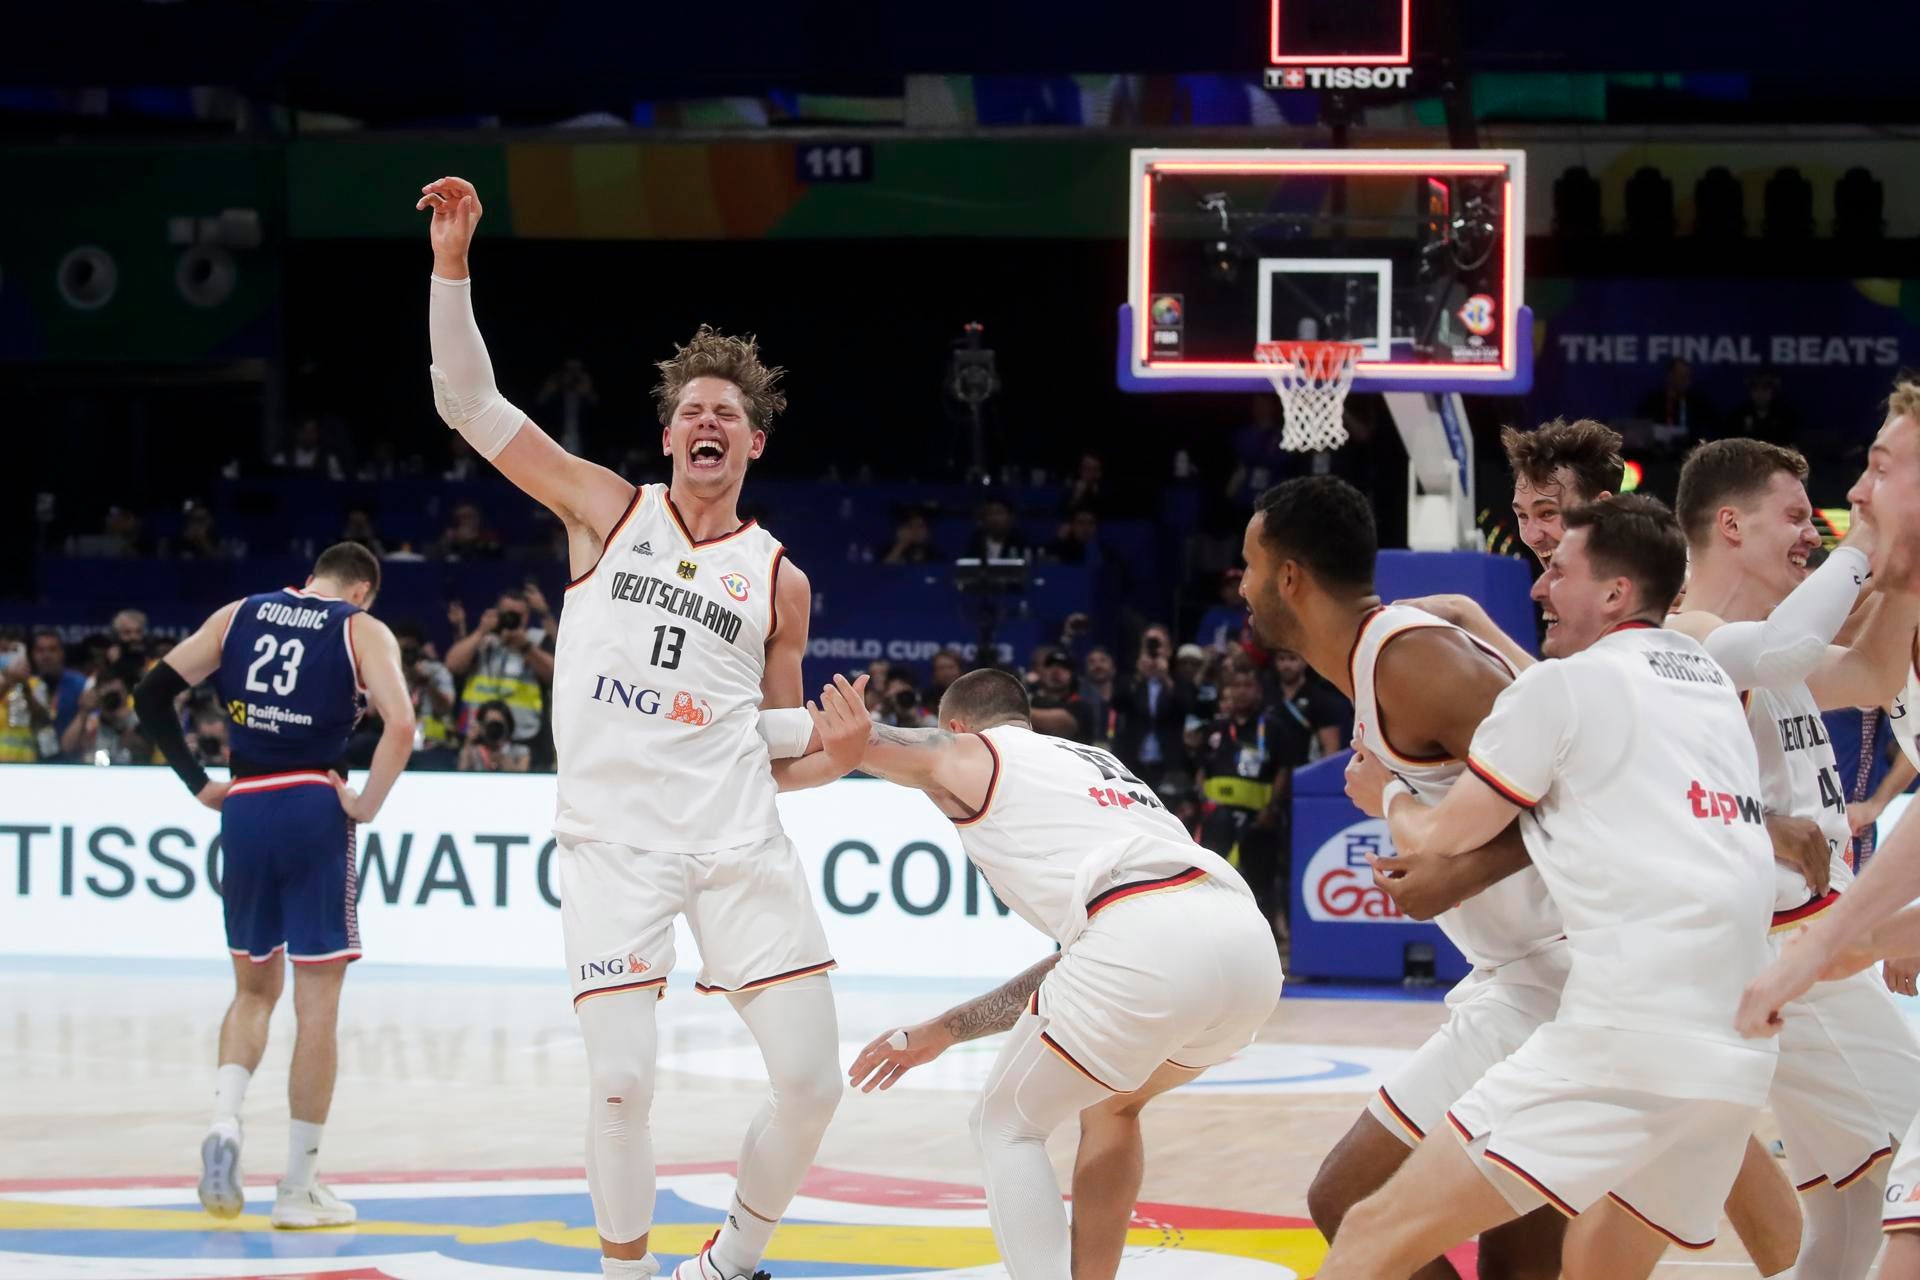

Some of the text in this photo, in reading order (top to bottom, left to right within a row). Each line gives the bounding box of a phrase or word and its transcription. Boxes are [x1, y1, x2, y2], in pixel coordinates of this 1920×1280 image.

[1305, 67, 1413, 89] TISSOT
[806, 148, 862, 176] 111
[1559, 335, 1898, 365] THE FINAL BEATS
[612, 572, 742, 644] DEUTSCHLAND
[650, 625, 686, 670] 13
[887, 641, 940, 661] CUP
[245, 634, 304, 696] 23
[592, 674, 661, 715] ING
[247, 703, 312, 725] Raiffeisen
[247, 717, 280, 734] Bank
[1687, 780, 1765, 825] tipw
[1317, 868, 1404, 918] Ga
[580, 958, 625, 980] ING
